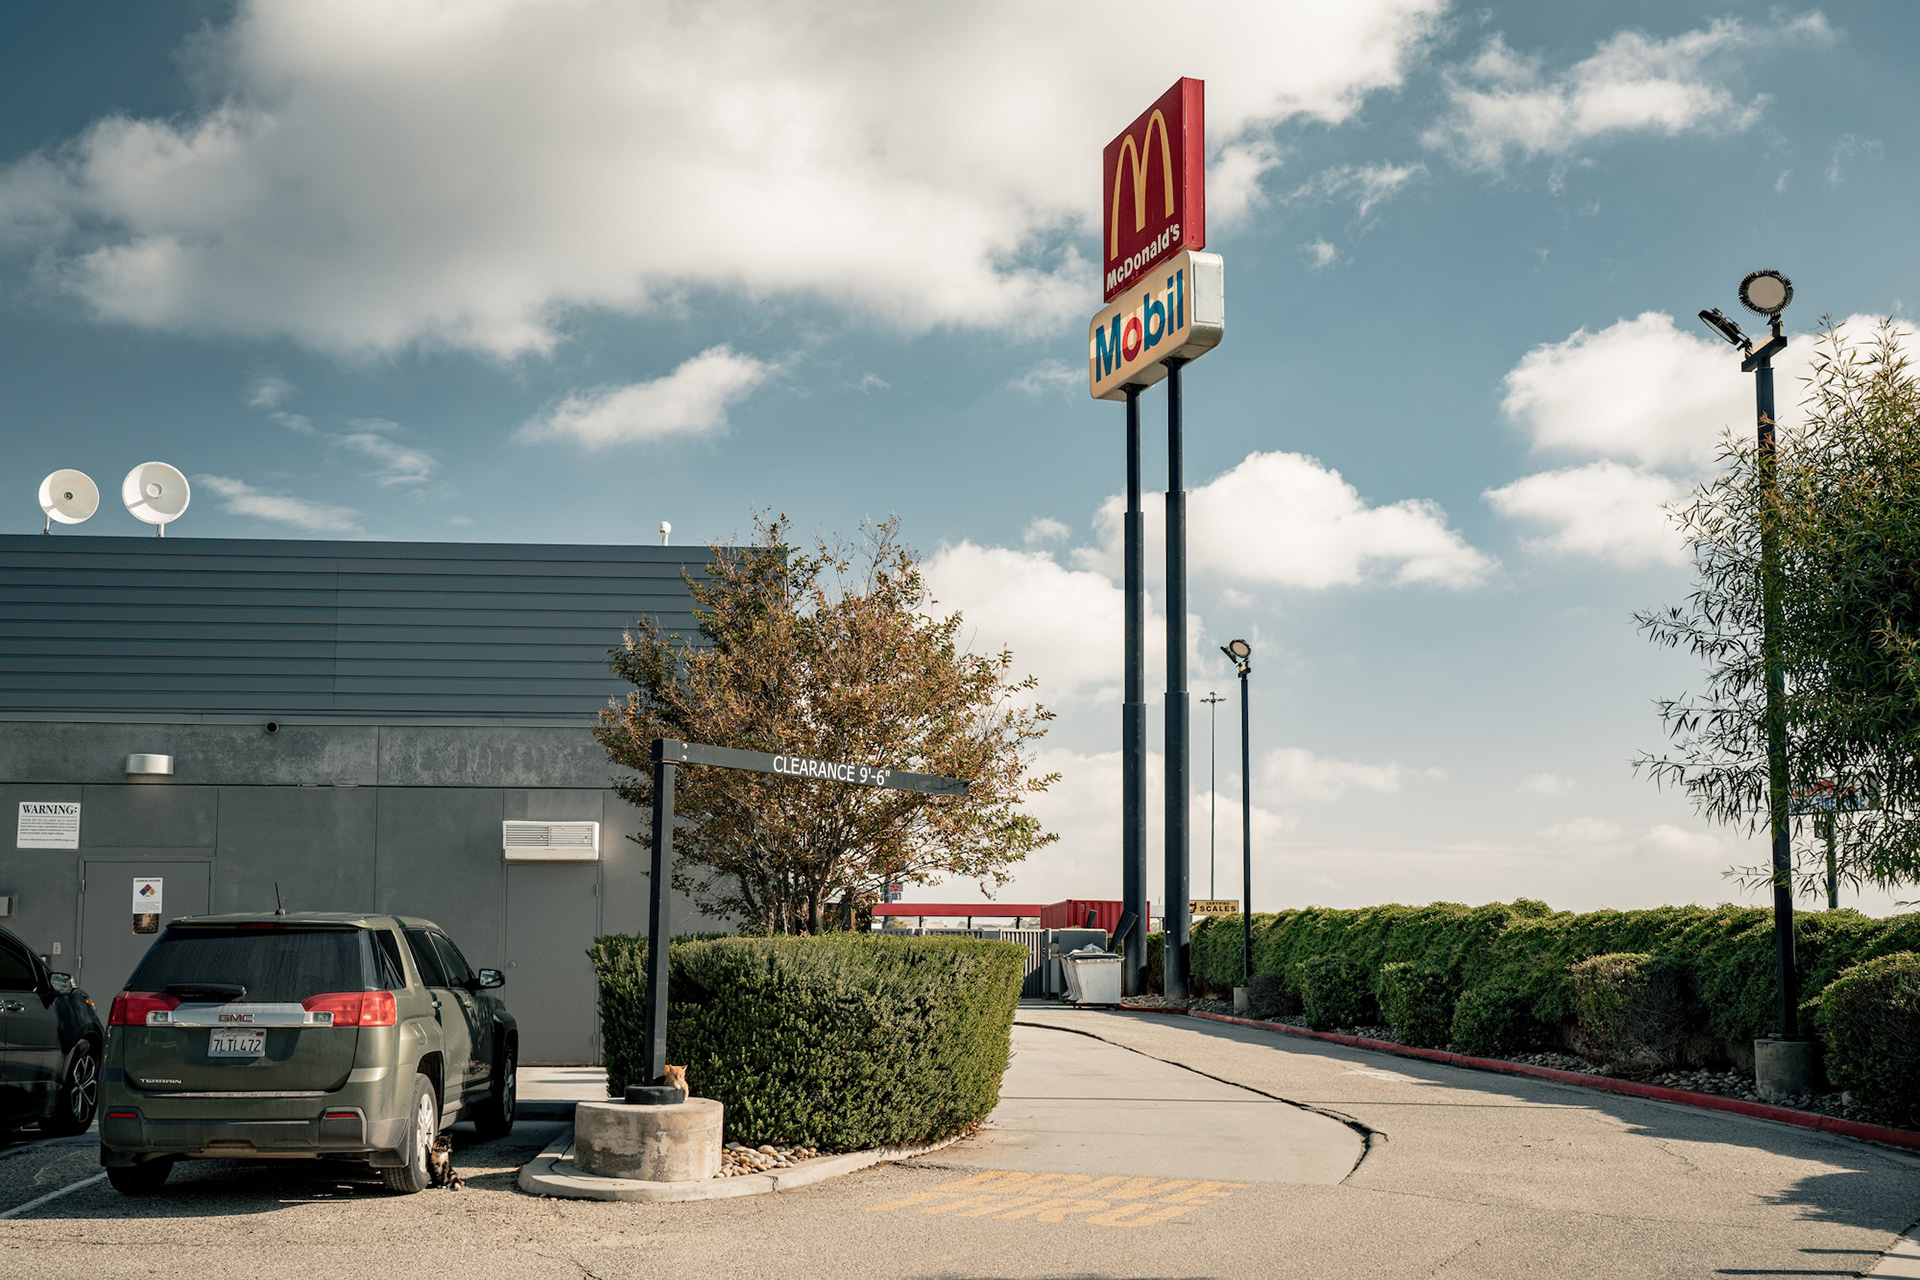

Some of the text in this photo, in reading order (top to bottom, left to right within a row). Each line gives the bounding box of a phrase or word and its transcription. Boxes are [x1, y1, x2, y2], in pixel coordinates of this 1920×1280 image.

[1106, 223, 1181, 293] McDonald's
[1095, 268, 1184, 383] Mobil
[773, 755, 855, 783] CLEARANCE
[22, 804, 78, 815] WARNING:
[218, 1013, 255, 1023] GMC
[213, 1039, 262, 1052] 7LTL472
